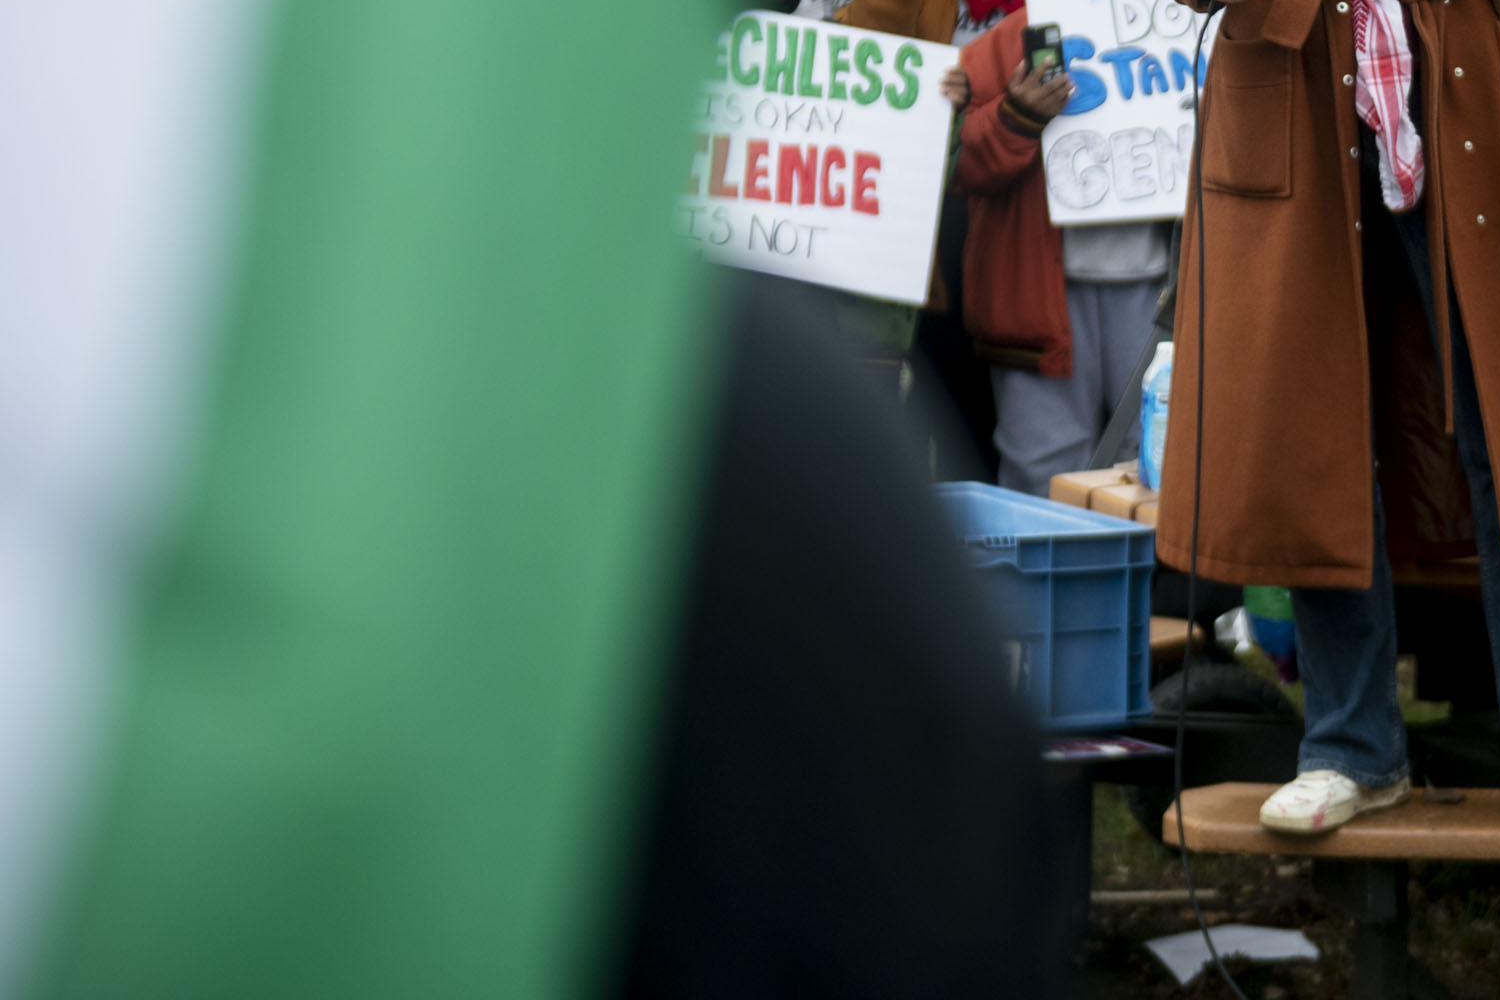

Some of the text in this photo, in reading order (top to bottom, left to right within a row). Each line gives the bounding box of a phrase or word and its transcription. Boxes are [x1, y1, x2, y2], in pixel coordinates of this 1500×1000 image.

[754, 98, 843, 134] OKAY
[679, 205, 829, 258] IS NOT
